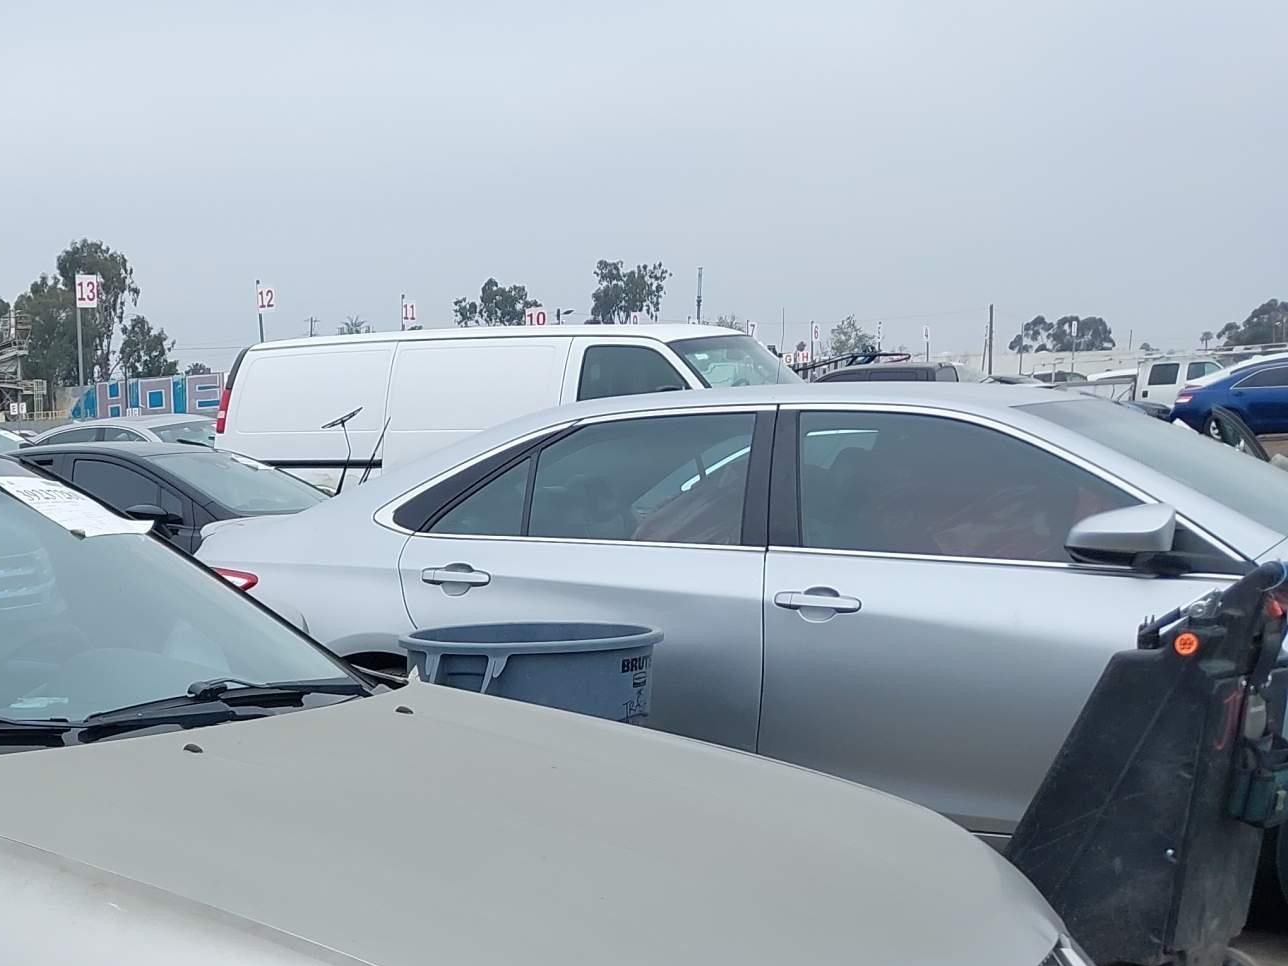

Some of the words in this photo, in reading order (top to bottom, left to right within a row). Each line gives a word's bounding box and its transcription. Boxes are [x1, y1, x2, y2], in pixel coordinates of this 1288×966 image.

[78, 281, 95, 301] 13
[259, 290, 274, 308] 12
[403, 304, 416, 320] 11
[527, 312, 546, 325] 10
[813, 325, 819, 339] 6
[785, 355, 792, 363] G
[802, 352, 809, 361] H
